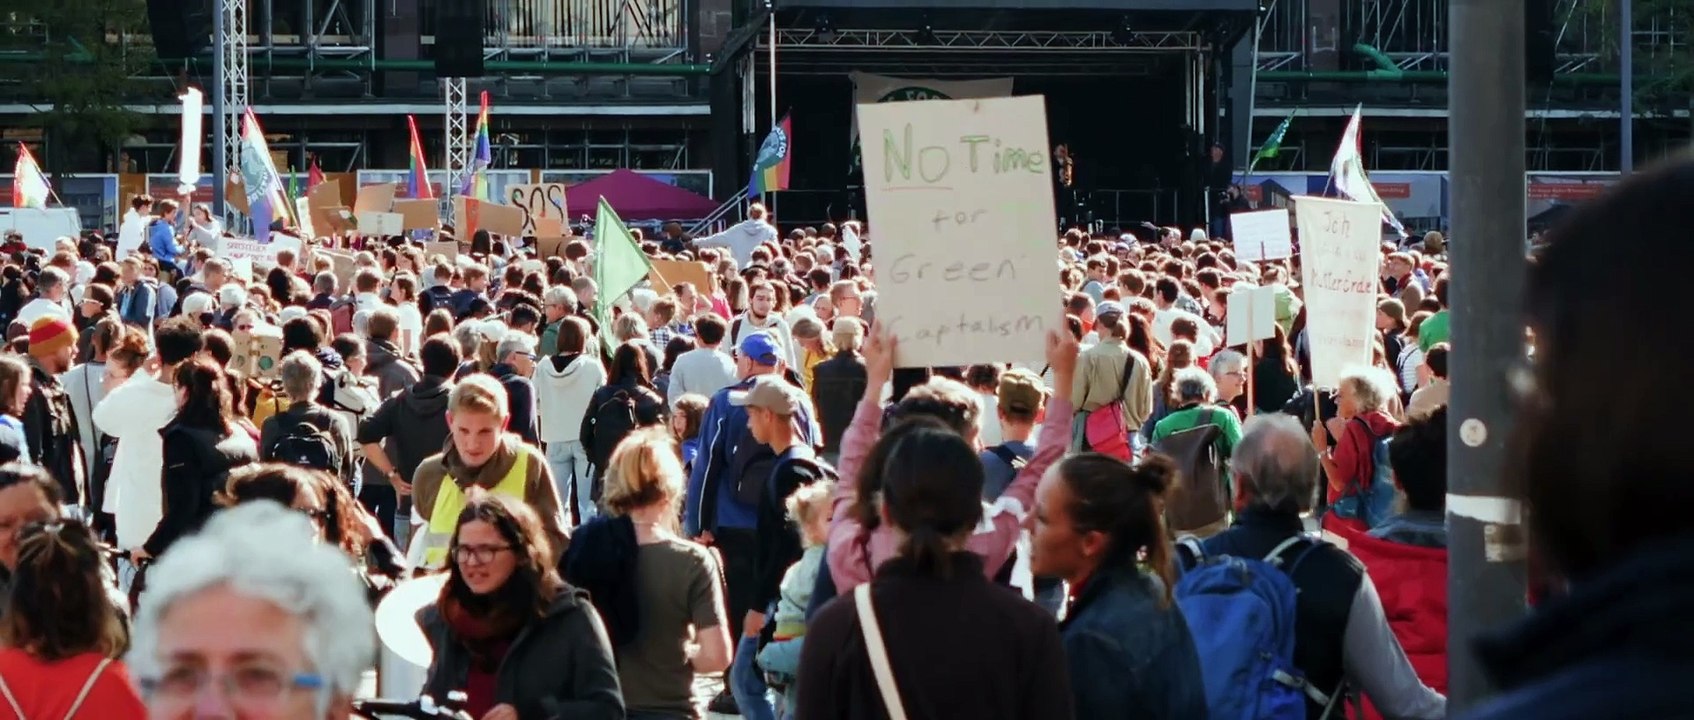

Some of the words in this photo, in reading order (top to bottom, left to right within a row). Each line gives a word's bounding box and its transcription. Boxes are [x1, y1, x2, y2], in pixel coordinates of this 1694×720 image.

[959, 135, 1044, 174] Time
[512, 185, 564, 230] SOS
[932, 208, 987, 232] for
[890, 253, 1016, 284] Green
